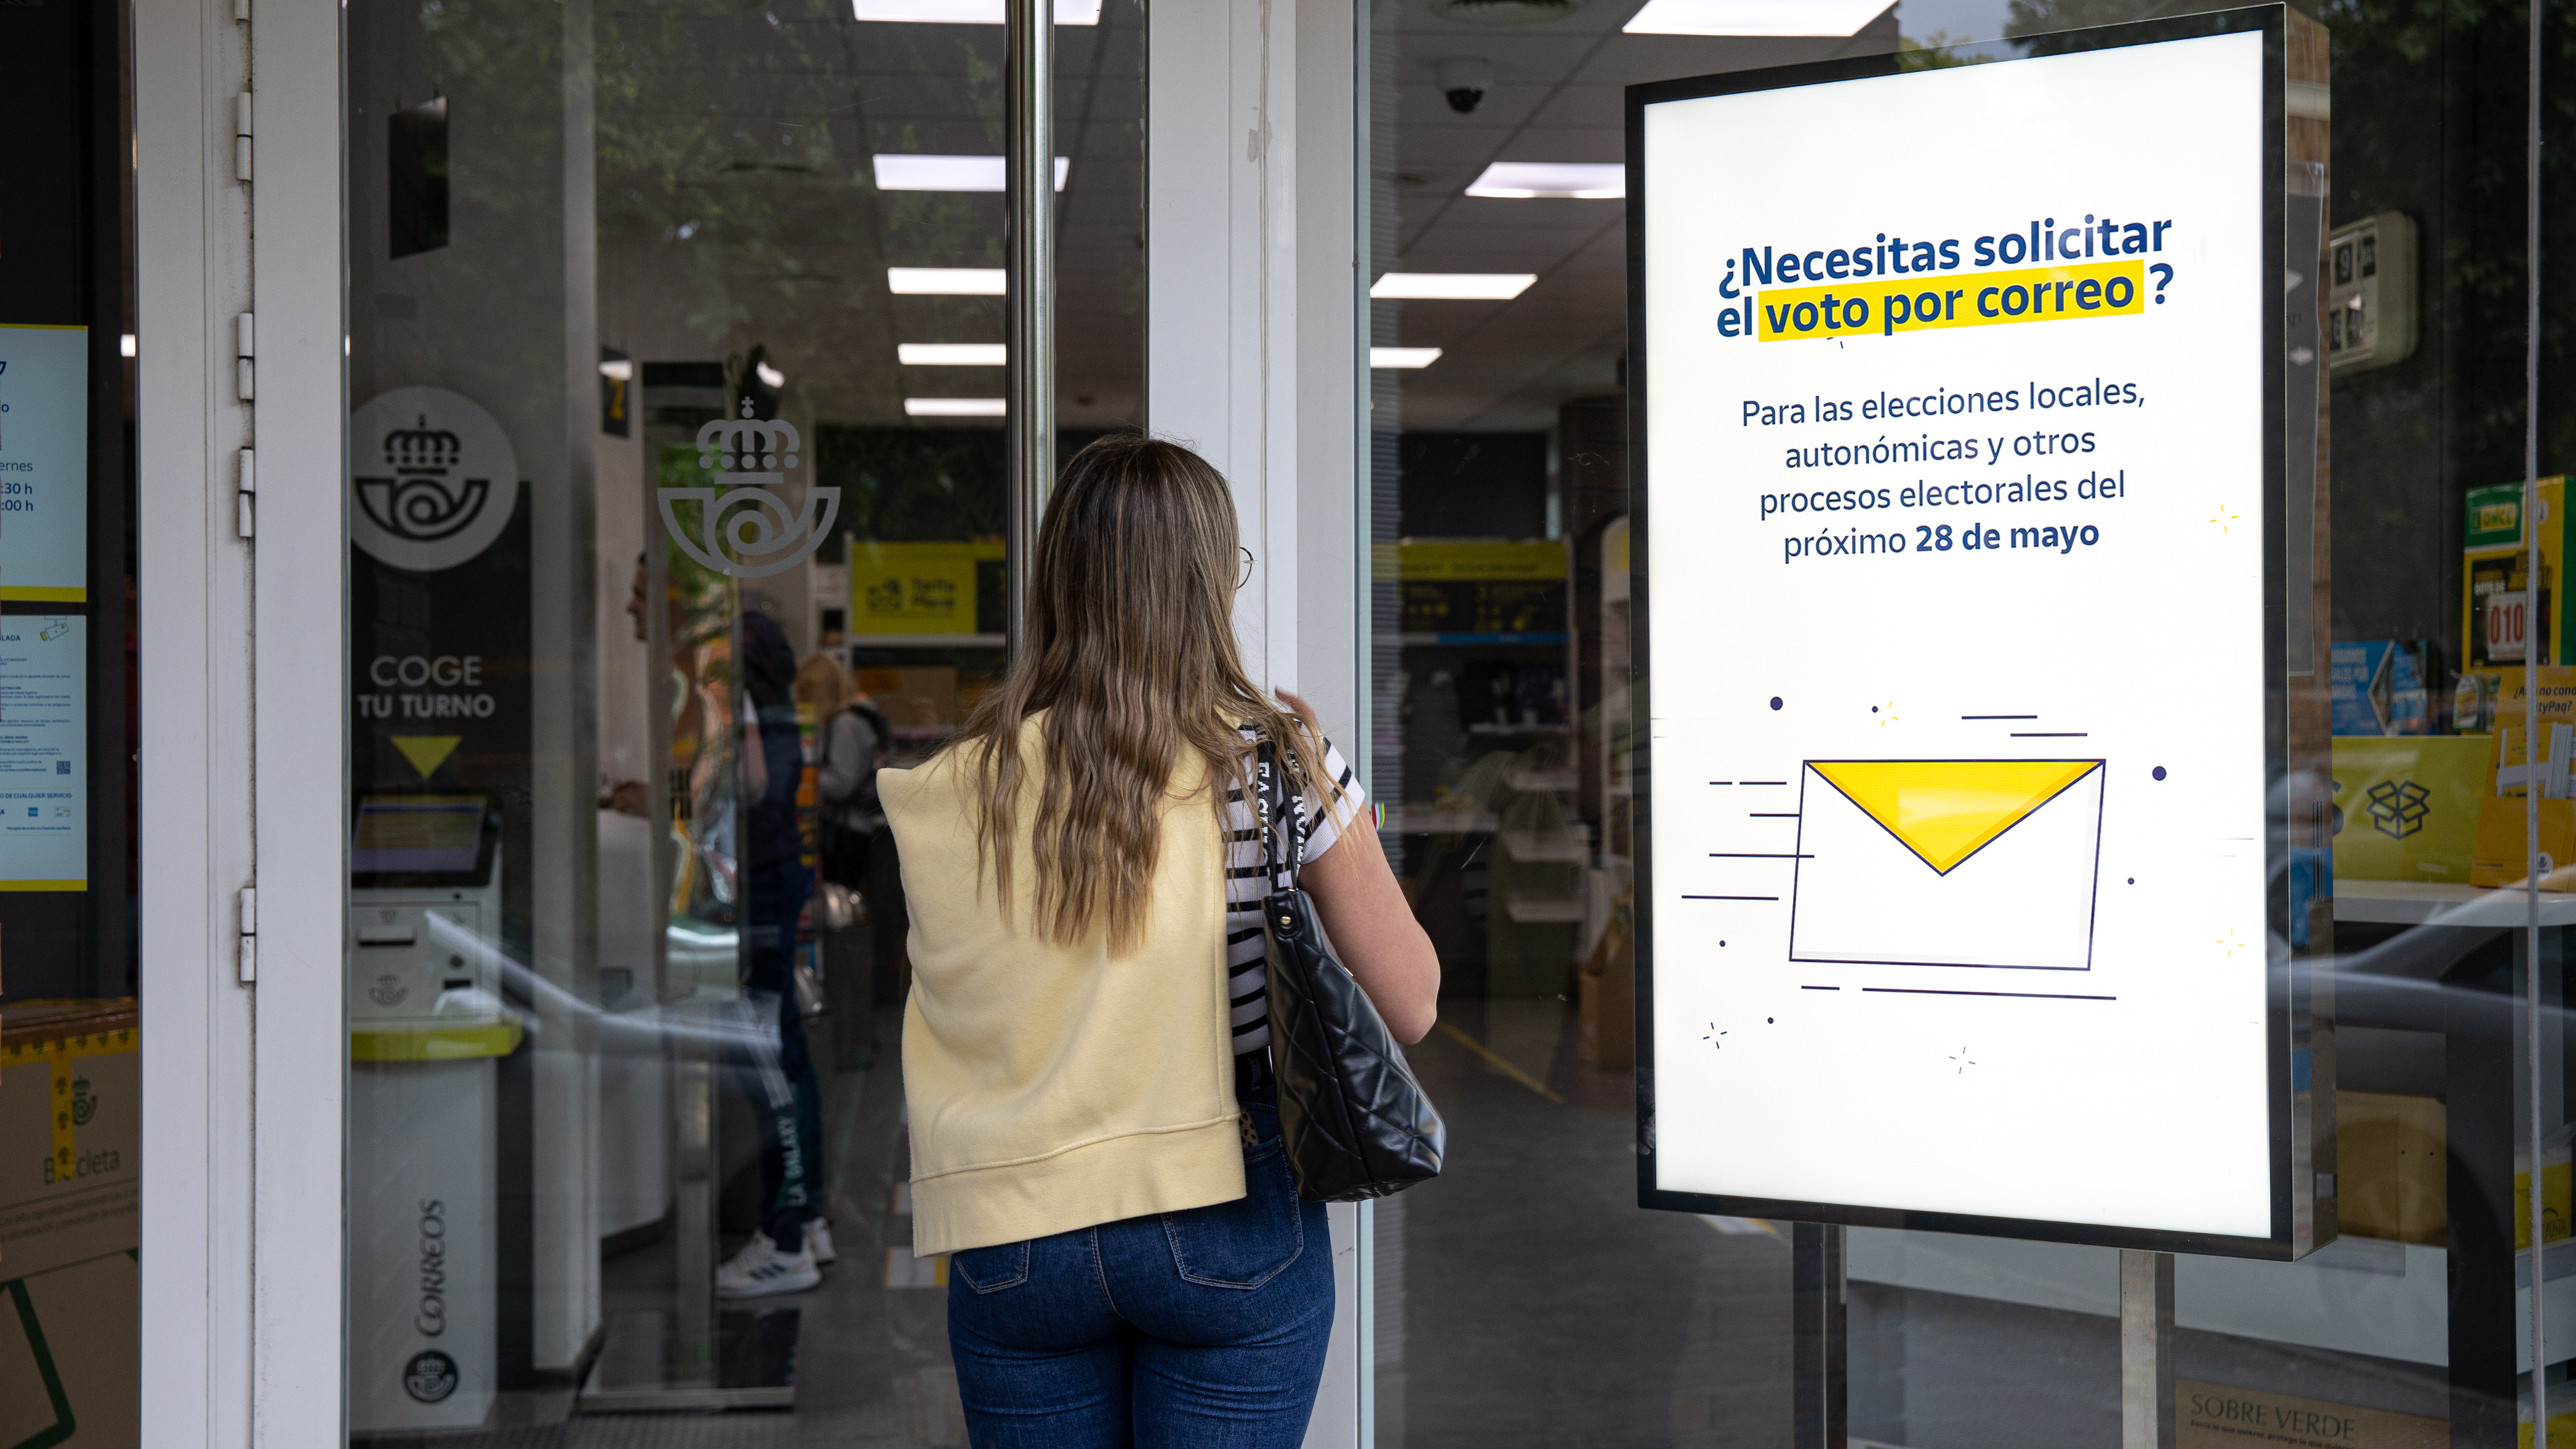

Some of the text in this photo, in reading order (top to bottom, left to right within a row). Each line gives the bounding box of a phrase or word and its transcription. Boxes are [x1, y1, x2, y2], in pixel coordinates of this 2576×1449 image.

[1720, 214, 2171, 299] ¿Necesitas solicitar
[1717, 297, 1752, 337] el
[1765, 294, 1869, 333] voto
[1885, 289, 1963, 336] por
[1978, 277, 2133, 317] correo
[1744, 378, 2144, 426] Para las elecciones locales,
[1786, 432, 2095, 468] autonómicas y otros
[25, 483, 33, 494] h
[25, 499, 33, 511] h
[1762, 470, 2124, 521] procesos electorales del
[1786, 523, 2099, 564] próximo 28 de mayo
[2489, 602, 2524, 645] 010
[370, 655, 482, 686] COGE
[358, 693, 496, 718] TU TURNO
[2536, 699, 2572, 715] tyPaq?
[2540, 687, 2551, 696] no
[44, 1150, 120, 1184] Bcleta
[2191, 1393, 2356, 1440] SOBRE VERDE
